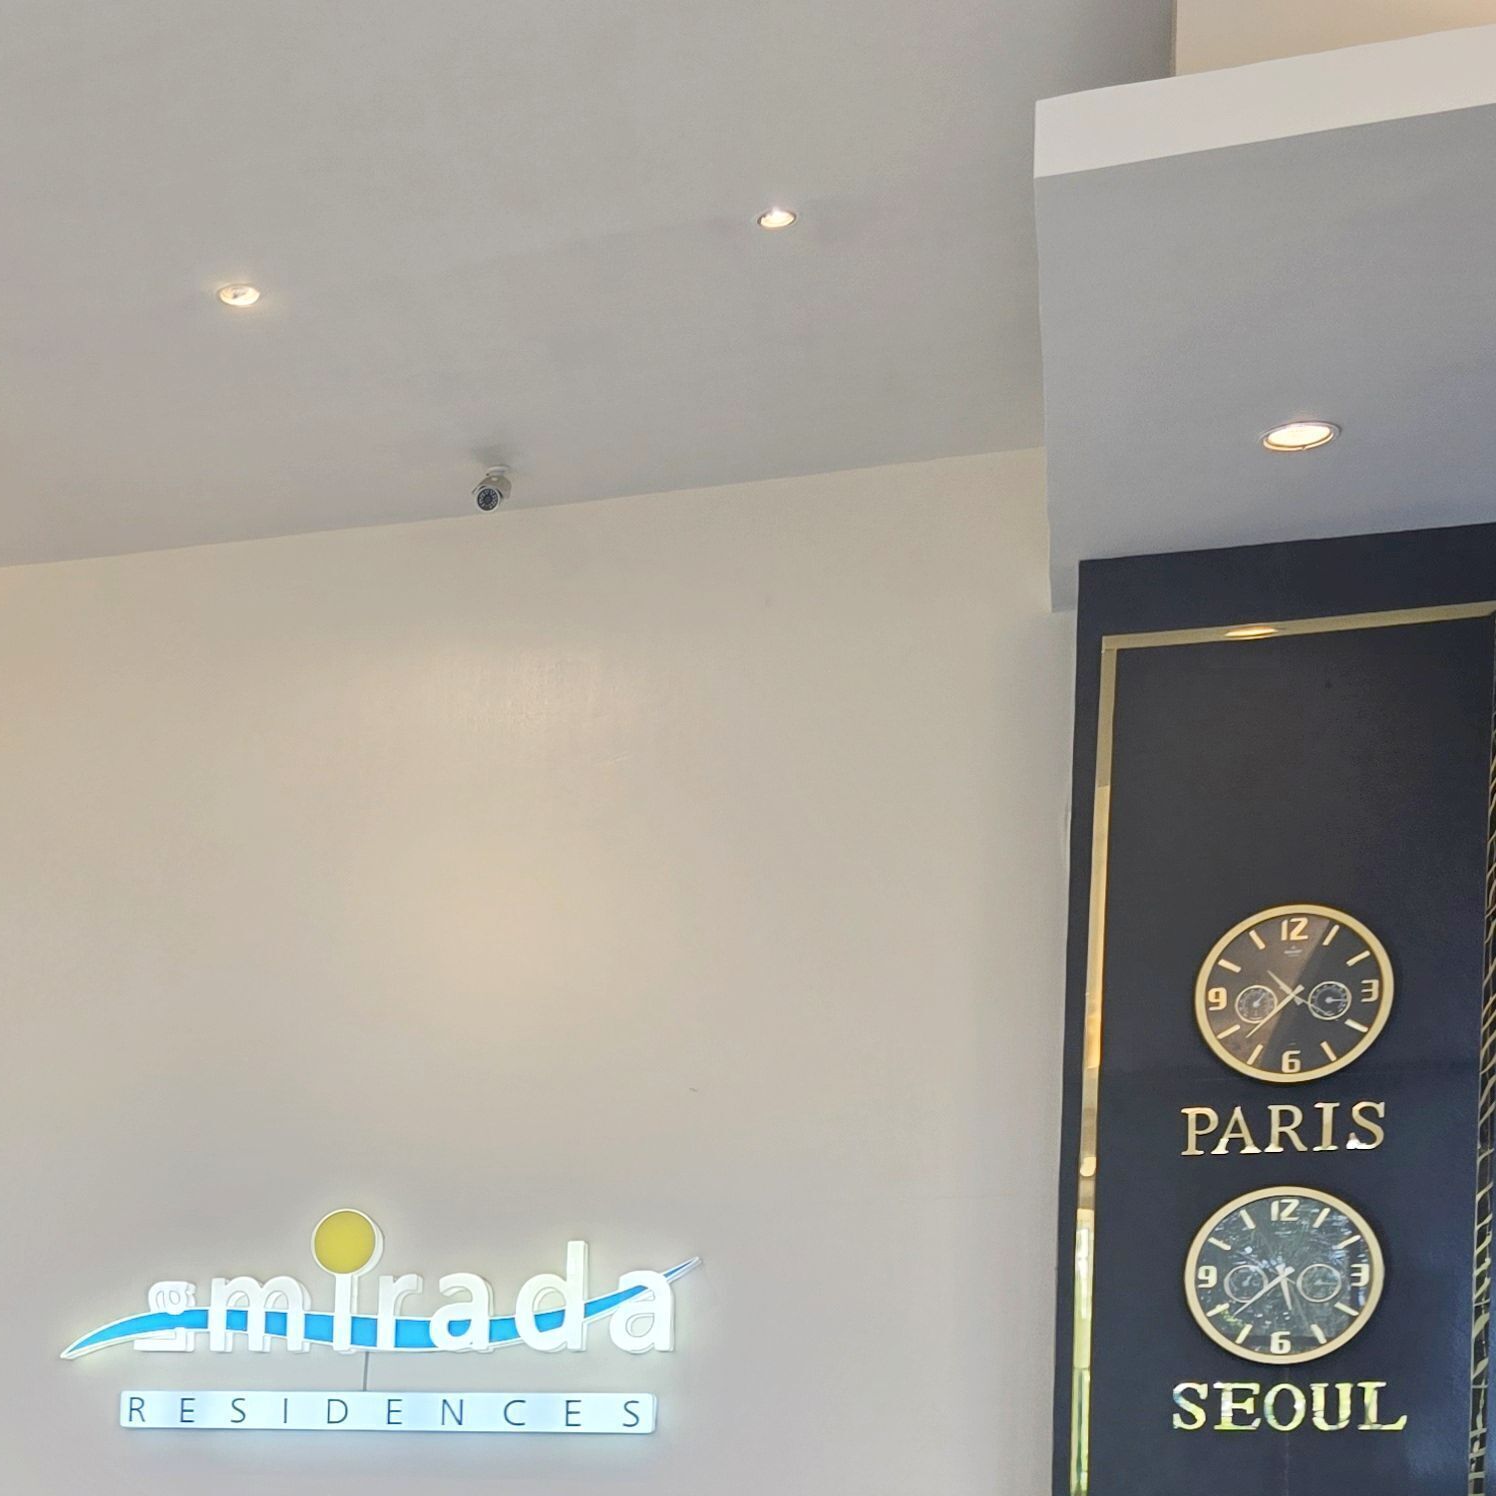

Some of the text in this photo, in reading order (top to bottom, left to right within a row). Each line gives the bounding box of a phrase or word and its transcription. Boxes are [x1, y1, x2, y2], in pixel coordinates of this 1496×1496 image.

[1281, 917, 1308, 941] 12
[1208, 987, 1227, 1011] 9
[1360, 978, 1379, 1003] 3
[1281, 1050, 1301, 1074] 6
[1180, 1101, 1386, 1156] PARIS
[1270, 1199, 1300, 1221] 12
[209, 1208, 676, 1354] mirada
[1197, 1265, 1218, 1288] 9
[1350, 1263, 1370, 1287] 3
[1270, 1331, 1292, 1354] 6
[128, 1396, 642, 1429] RESIDENCES
[1172, 1381, 1408, 1431] SEOUL
